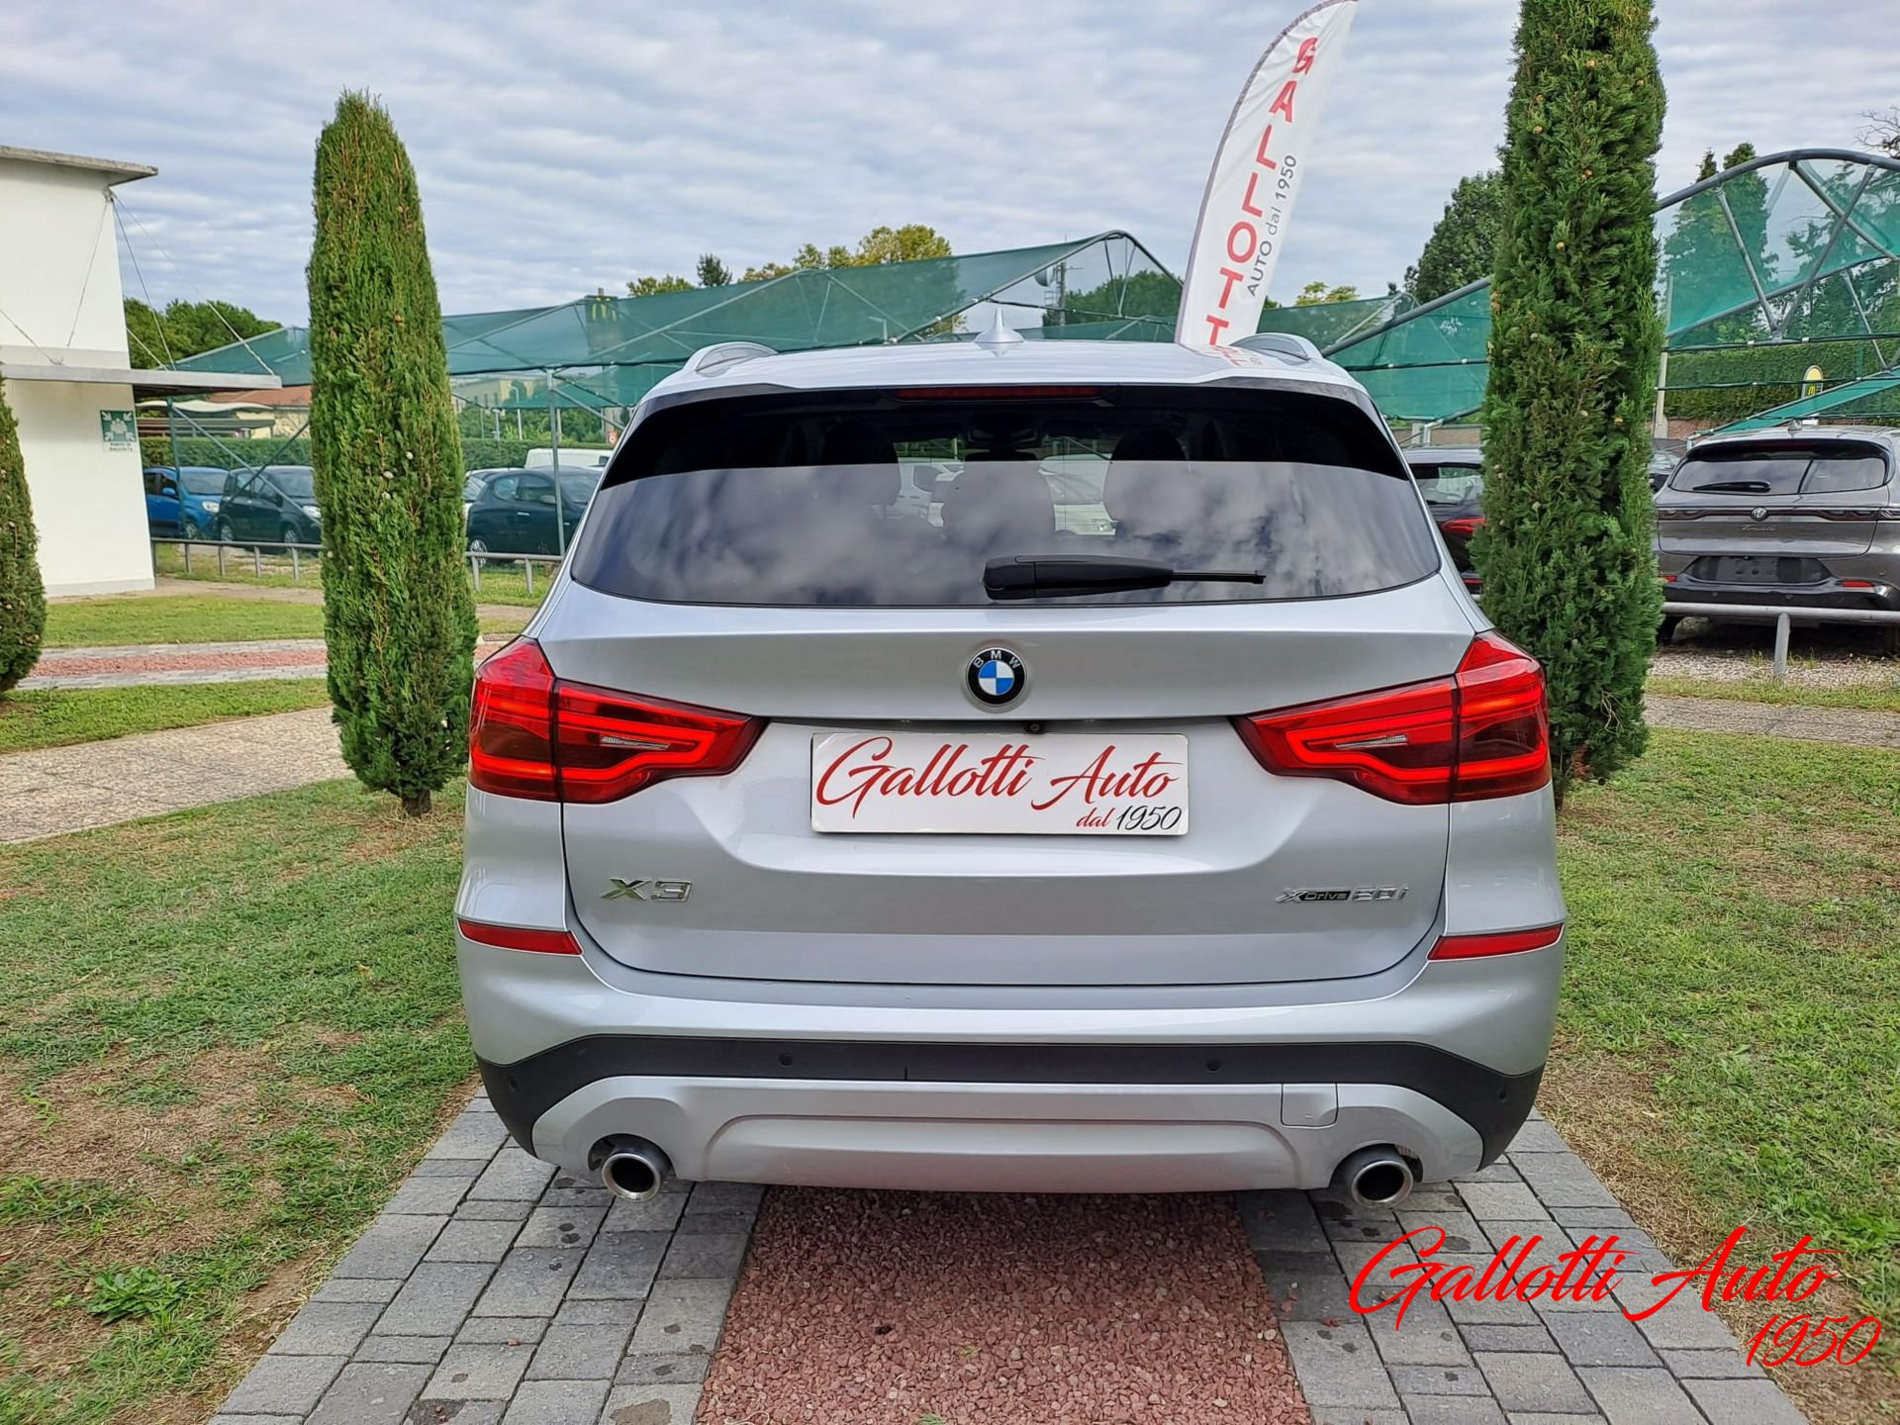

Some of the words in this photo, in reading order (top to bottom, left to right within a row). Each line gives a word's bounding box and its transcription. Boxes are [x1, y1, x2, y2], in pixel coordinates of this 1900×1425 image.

[1206, 37, 1318, 346] GALLOTT
[1247, 241, 1272, 297] AUTO
[1266, 206, 1282, 236] dal
[1275, 154, 1297, 200] 1950
[972, 650, 1021, 669] BMW
[816, 736, 1046, 819] Gallotti
[1031, 744, 1185, 811] Auto
[1075, 807, 1117, 828] dal
[1115, 804, 1183, 831] 1950
[600, 877, 692, 902] X3
